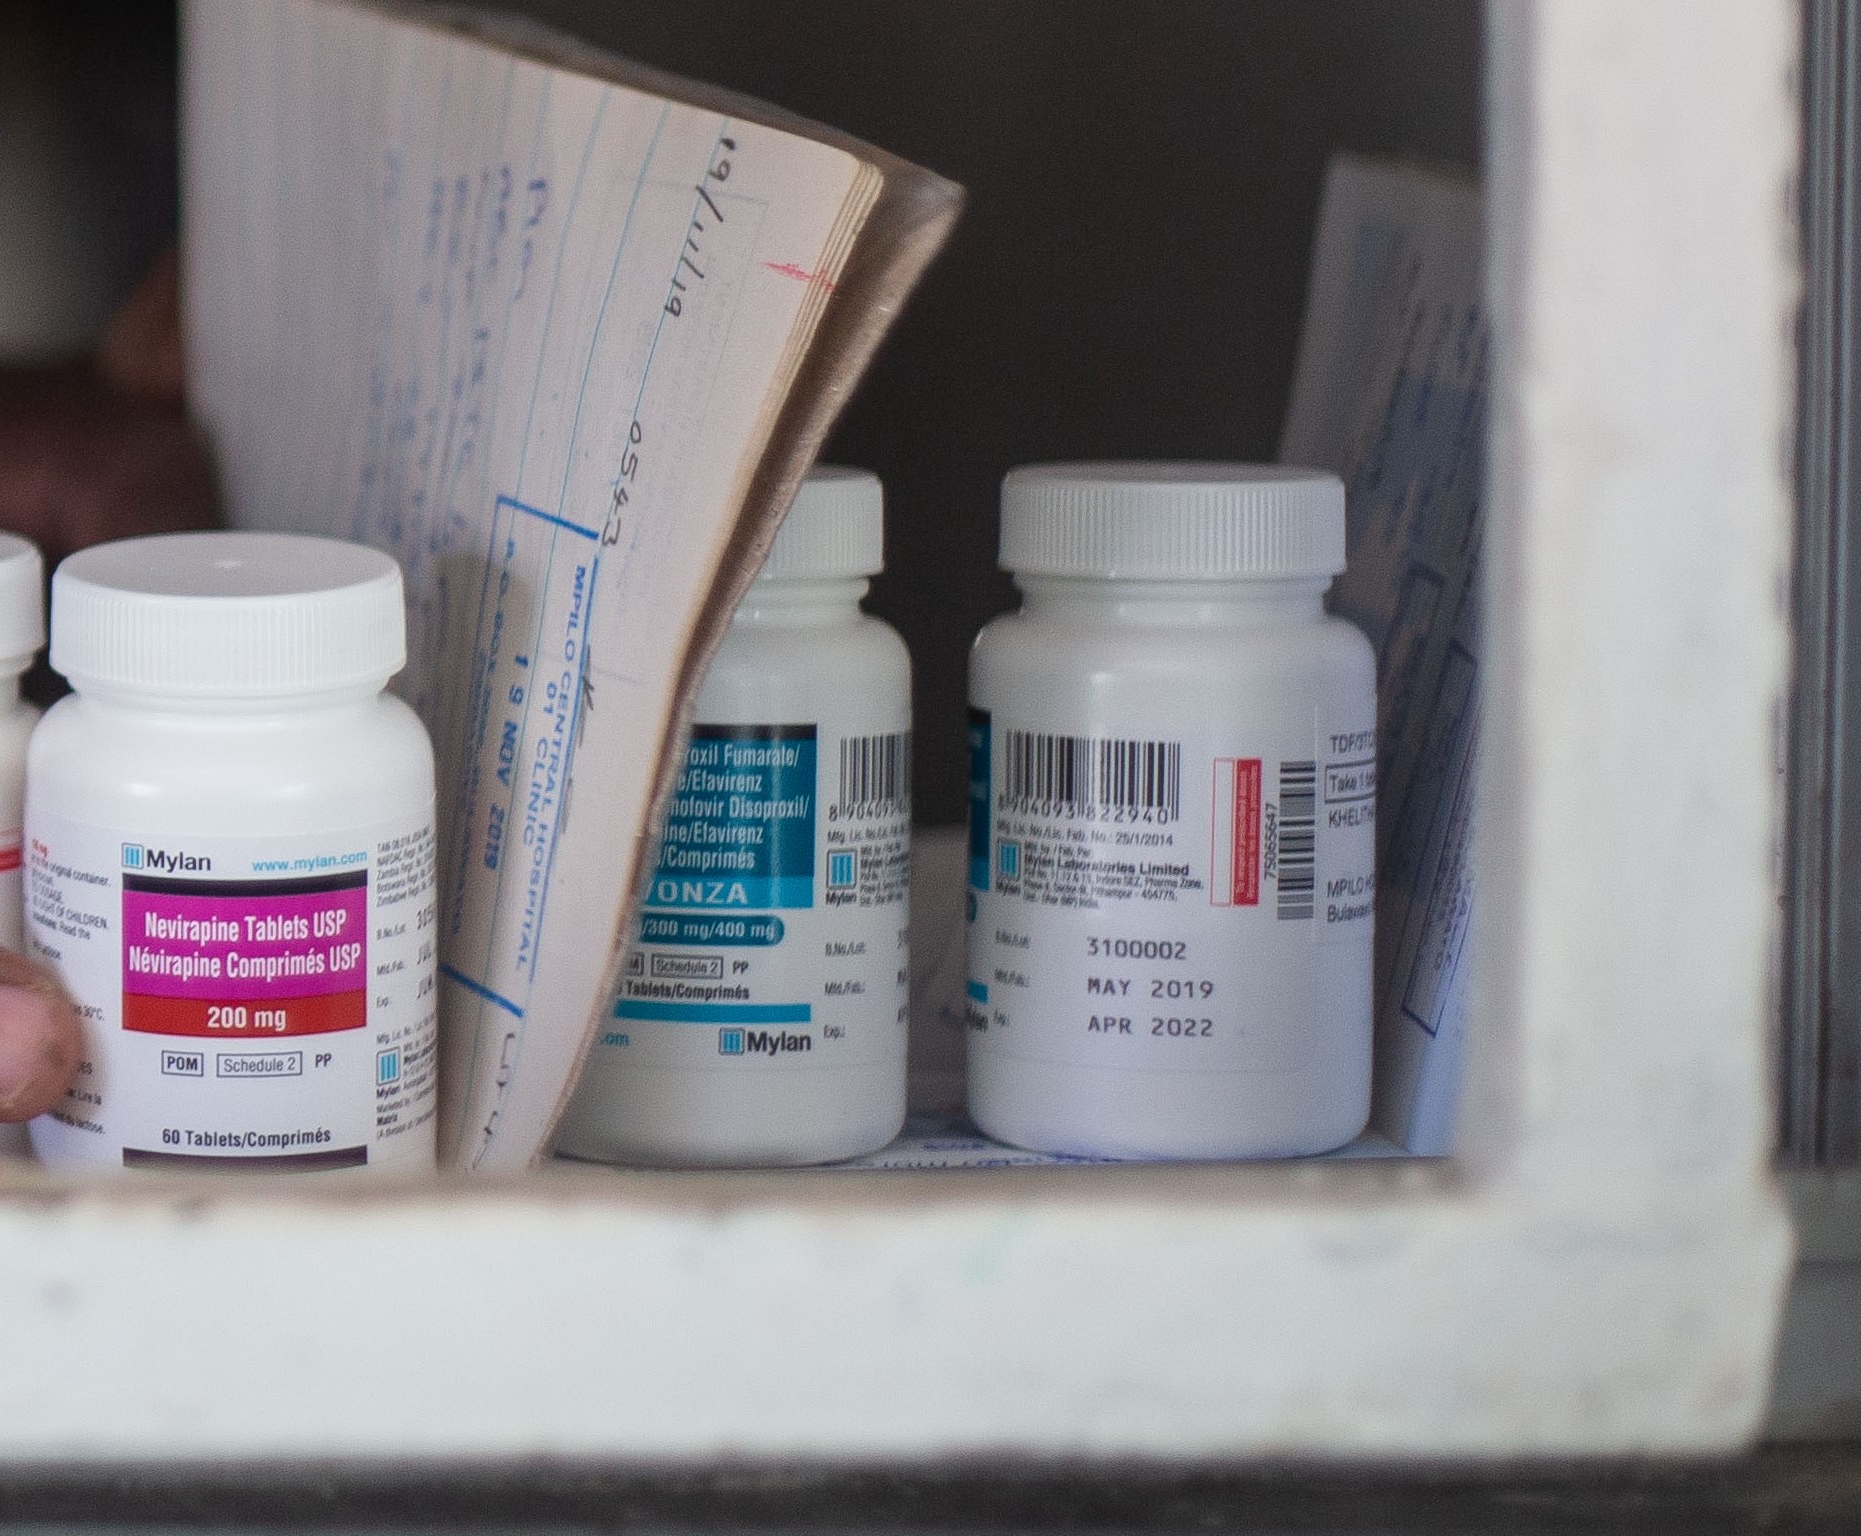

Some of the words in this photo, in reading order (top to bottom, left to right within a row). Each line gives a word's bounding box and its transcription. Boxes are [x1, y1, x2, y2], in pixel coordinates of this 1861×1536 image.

[598, 420, 642, 548] 0543
[562, 565, 586, 668] MPILO
[542, 672, 572, 807] CENTRAL
[496, 719, 518, 787] NOV
[683, 744, 719, 765] roxil
[523, 736, 548, 848] CLINIC
[676, 770, 763, 792] e/Efavirenz
[1329, 772, 1357, 794] Take
[669, 796, 724, 817] nofovir
[484, 802, 505, 871] 2019
[663, 821, 763, 845] ine/Efavirenz
[146, 849, 211, 873] Mylan
[252, 850, 368, 873] www.mylan.com
[658, 846, 755, 871] /Comprimés
[1057, 857, 1136, 875] Laboratories
[1140, 863, 1191, 877] Limited
[516, 821, 546, 971] HOSPITAL
[648, 880, 749, 905] ONZA
[826, 891, 857, 907] Mylan
[144, 911, 240, 946] Nevirapine
[244, 914, 309, 942] Tablets
[313, 908, 347, 939] USP
[683, 920, 745, 941] mg/400
[750, 921, 776, 941] mg
[1086, 936, 1187, 961] 3100002
[129, 945, 221, 981] Névirapine
[226, 947, 326, 982] Comprimés
[329, 942, 362, 972] USP
[656, 959, 708, 976] Schedule
[709, 959, 719, 975] 2
[732, 961, 749, 975] PP
[626, 980, 751, 1002] Tablets/Comprimés
[1087, 976, 1132, 996] MAY
[1151, 978, 1214, 1000] 2019
[207, 1006, 247, 1029] 200
[254, 1008, 287, 1031] mg
[1087, 1015, 1133, 1035] APR
[1151, 1017, 1214, 1038] 2022
[747, 1031, 812, 1056] Mylan
[166, 1055, 198, 1071] POM
[223, 1057, 283, 1073] Schedule
[286, 1056, 296, 1071] 2
[314, 1053, 332, 1068] PP
[162, 1128, 181, 1145] 60
[186, 1126, 332, 1150] Tablets/Comprimés
